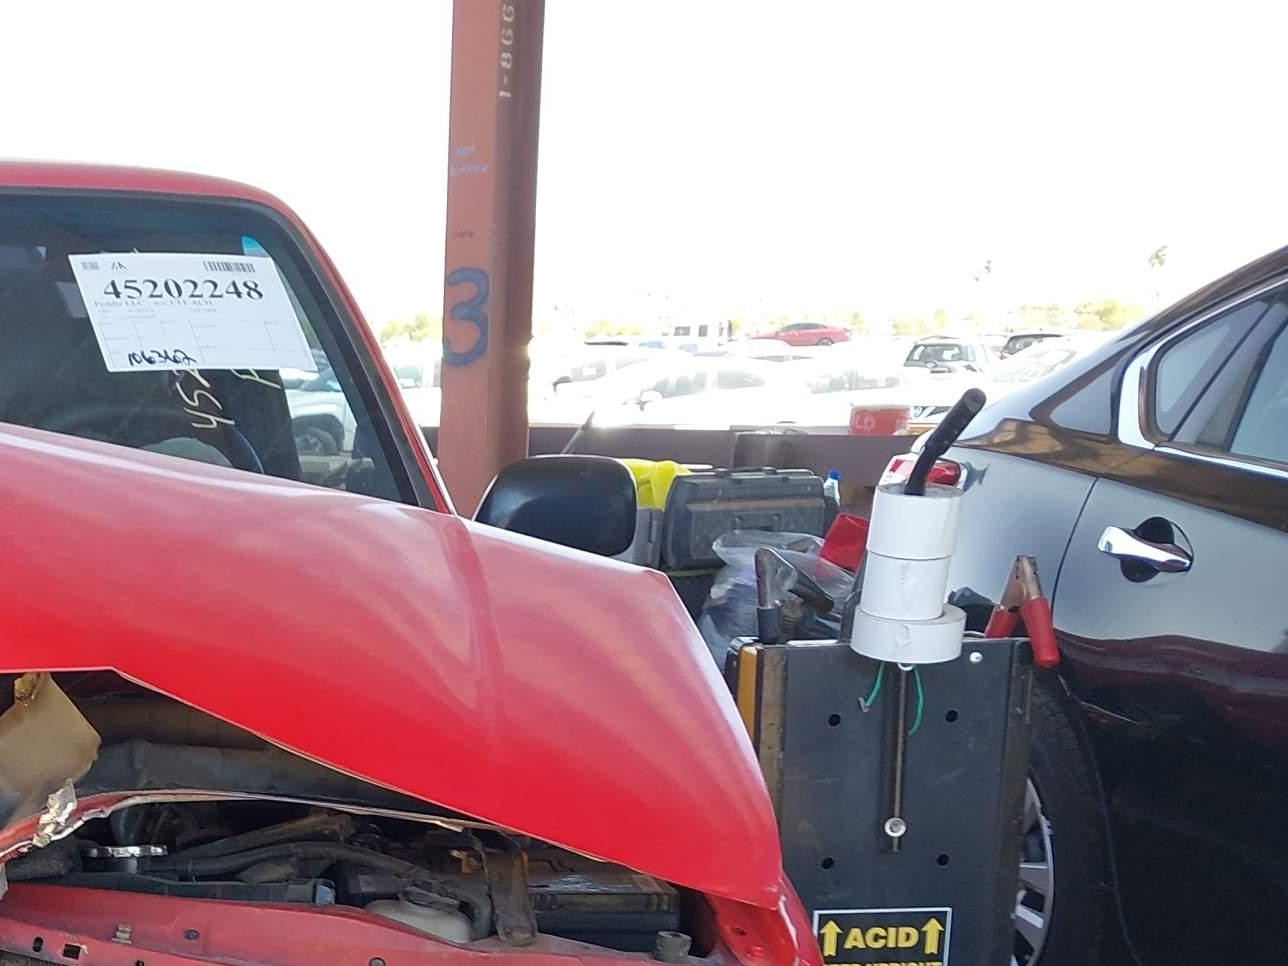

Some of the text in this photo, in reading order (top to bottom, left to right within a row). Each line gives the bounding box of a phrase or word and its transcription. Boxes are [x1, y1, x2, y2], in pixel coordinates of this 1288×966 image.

[104, 279, 263, 299] 45202248
[442, 266, 490, 367] 3
[844, 927, 919, 948] ACID
